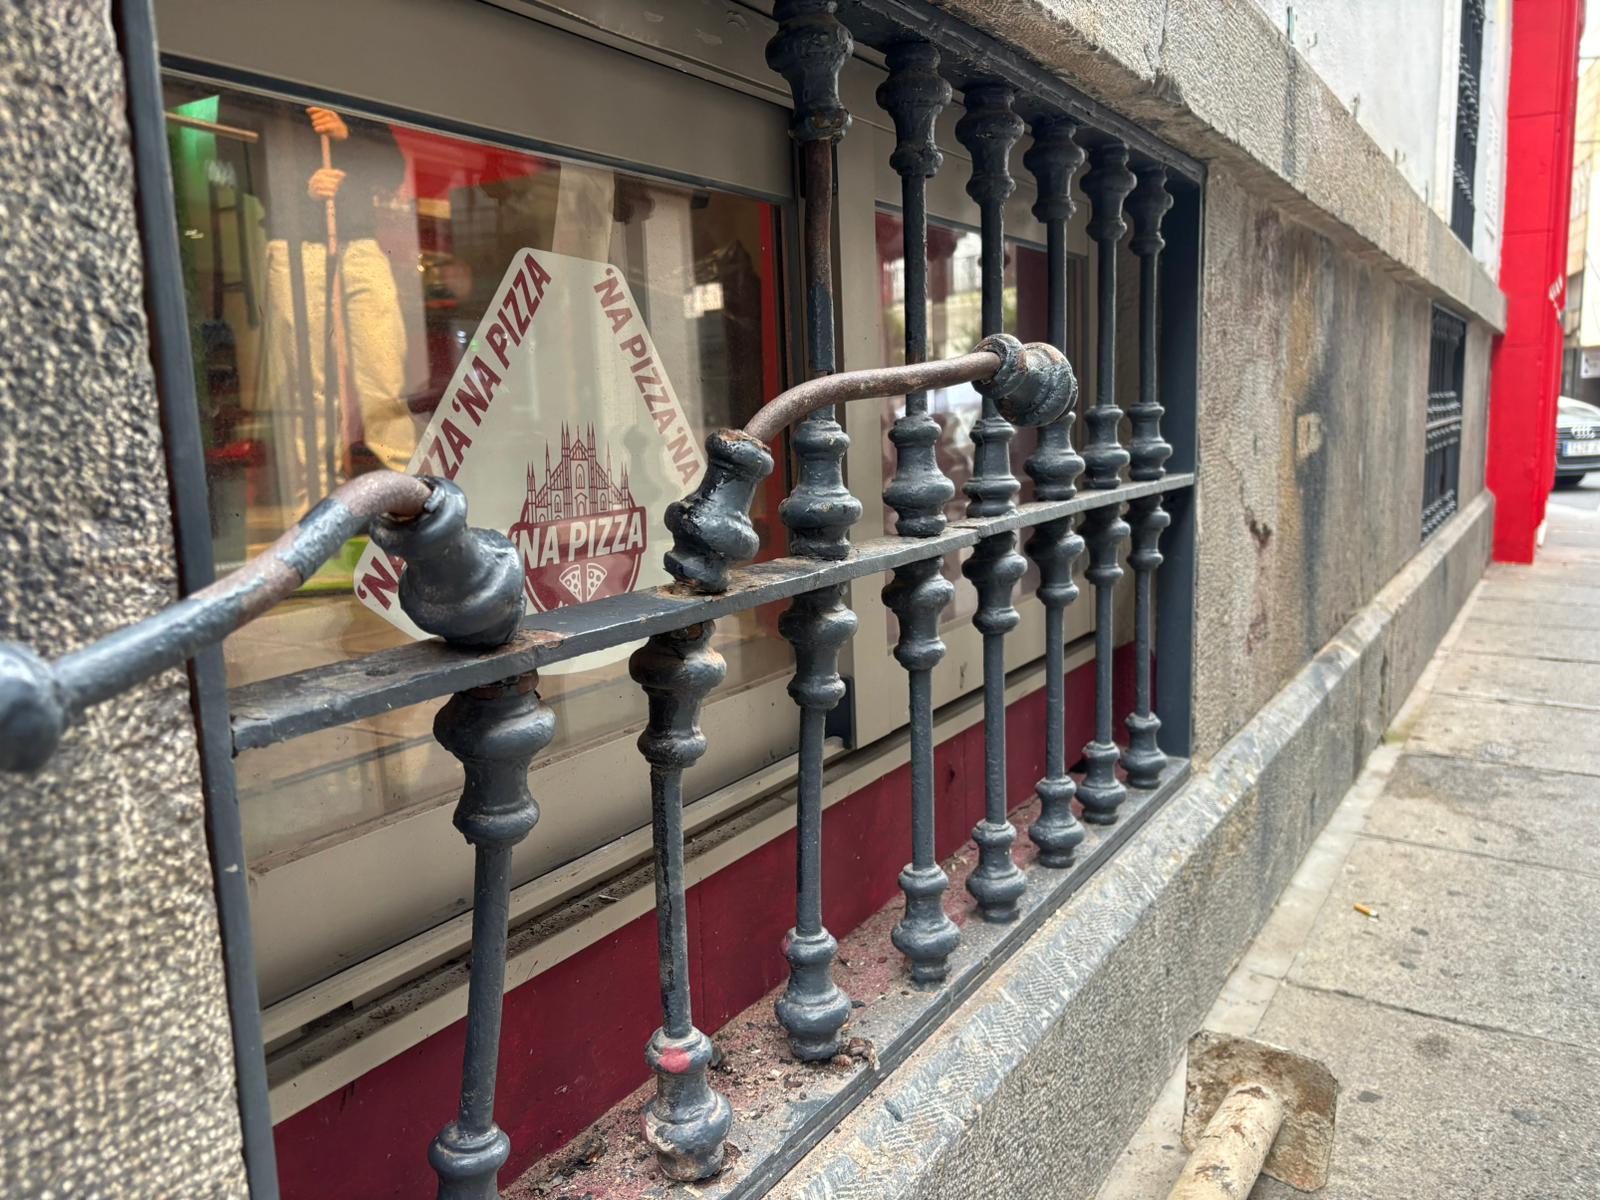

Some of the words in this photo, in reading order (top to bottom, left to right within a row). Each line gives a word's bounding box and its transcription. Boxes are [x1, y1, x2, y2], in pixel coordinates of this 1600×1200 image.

[485, 253, 552, 371] PIZZA
[619, 333, 678, 435] PIZZA
[568, 511, 644, 562] PIZZA
